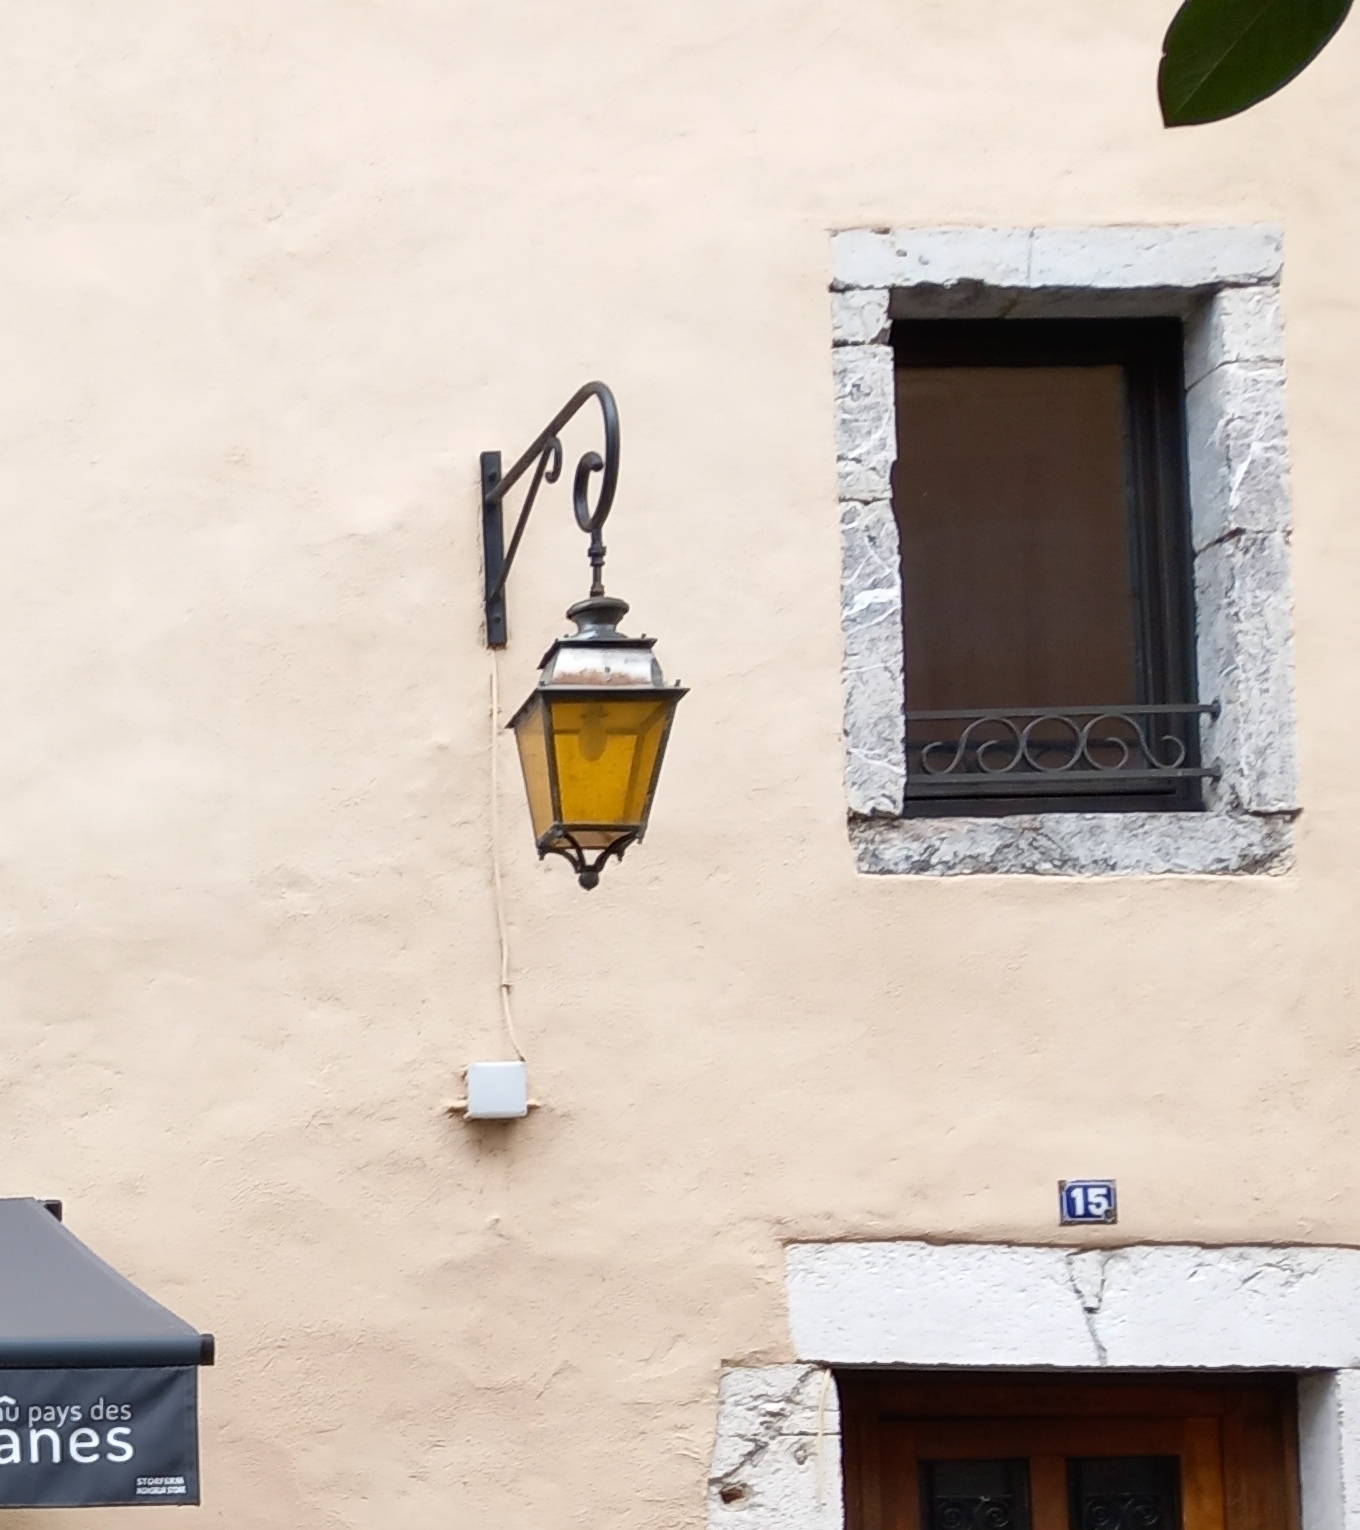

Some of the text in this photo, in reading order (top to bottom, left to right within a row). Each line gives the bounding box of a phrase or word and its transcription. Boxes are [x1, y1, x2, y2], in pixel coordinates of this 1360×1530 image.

[1070, 1187, 1109, 1217] 15
[28, 1405, 83, 1428] pays
[90, 1396, 132, 1421] des
